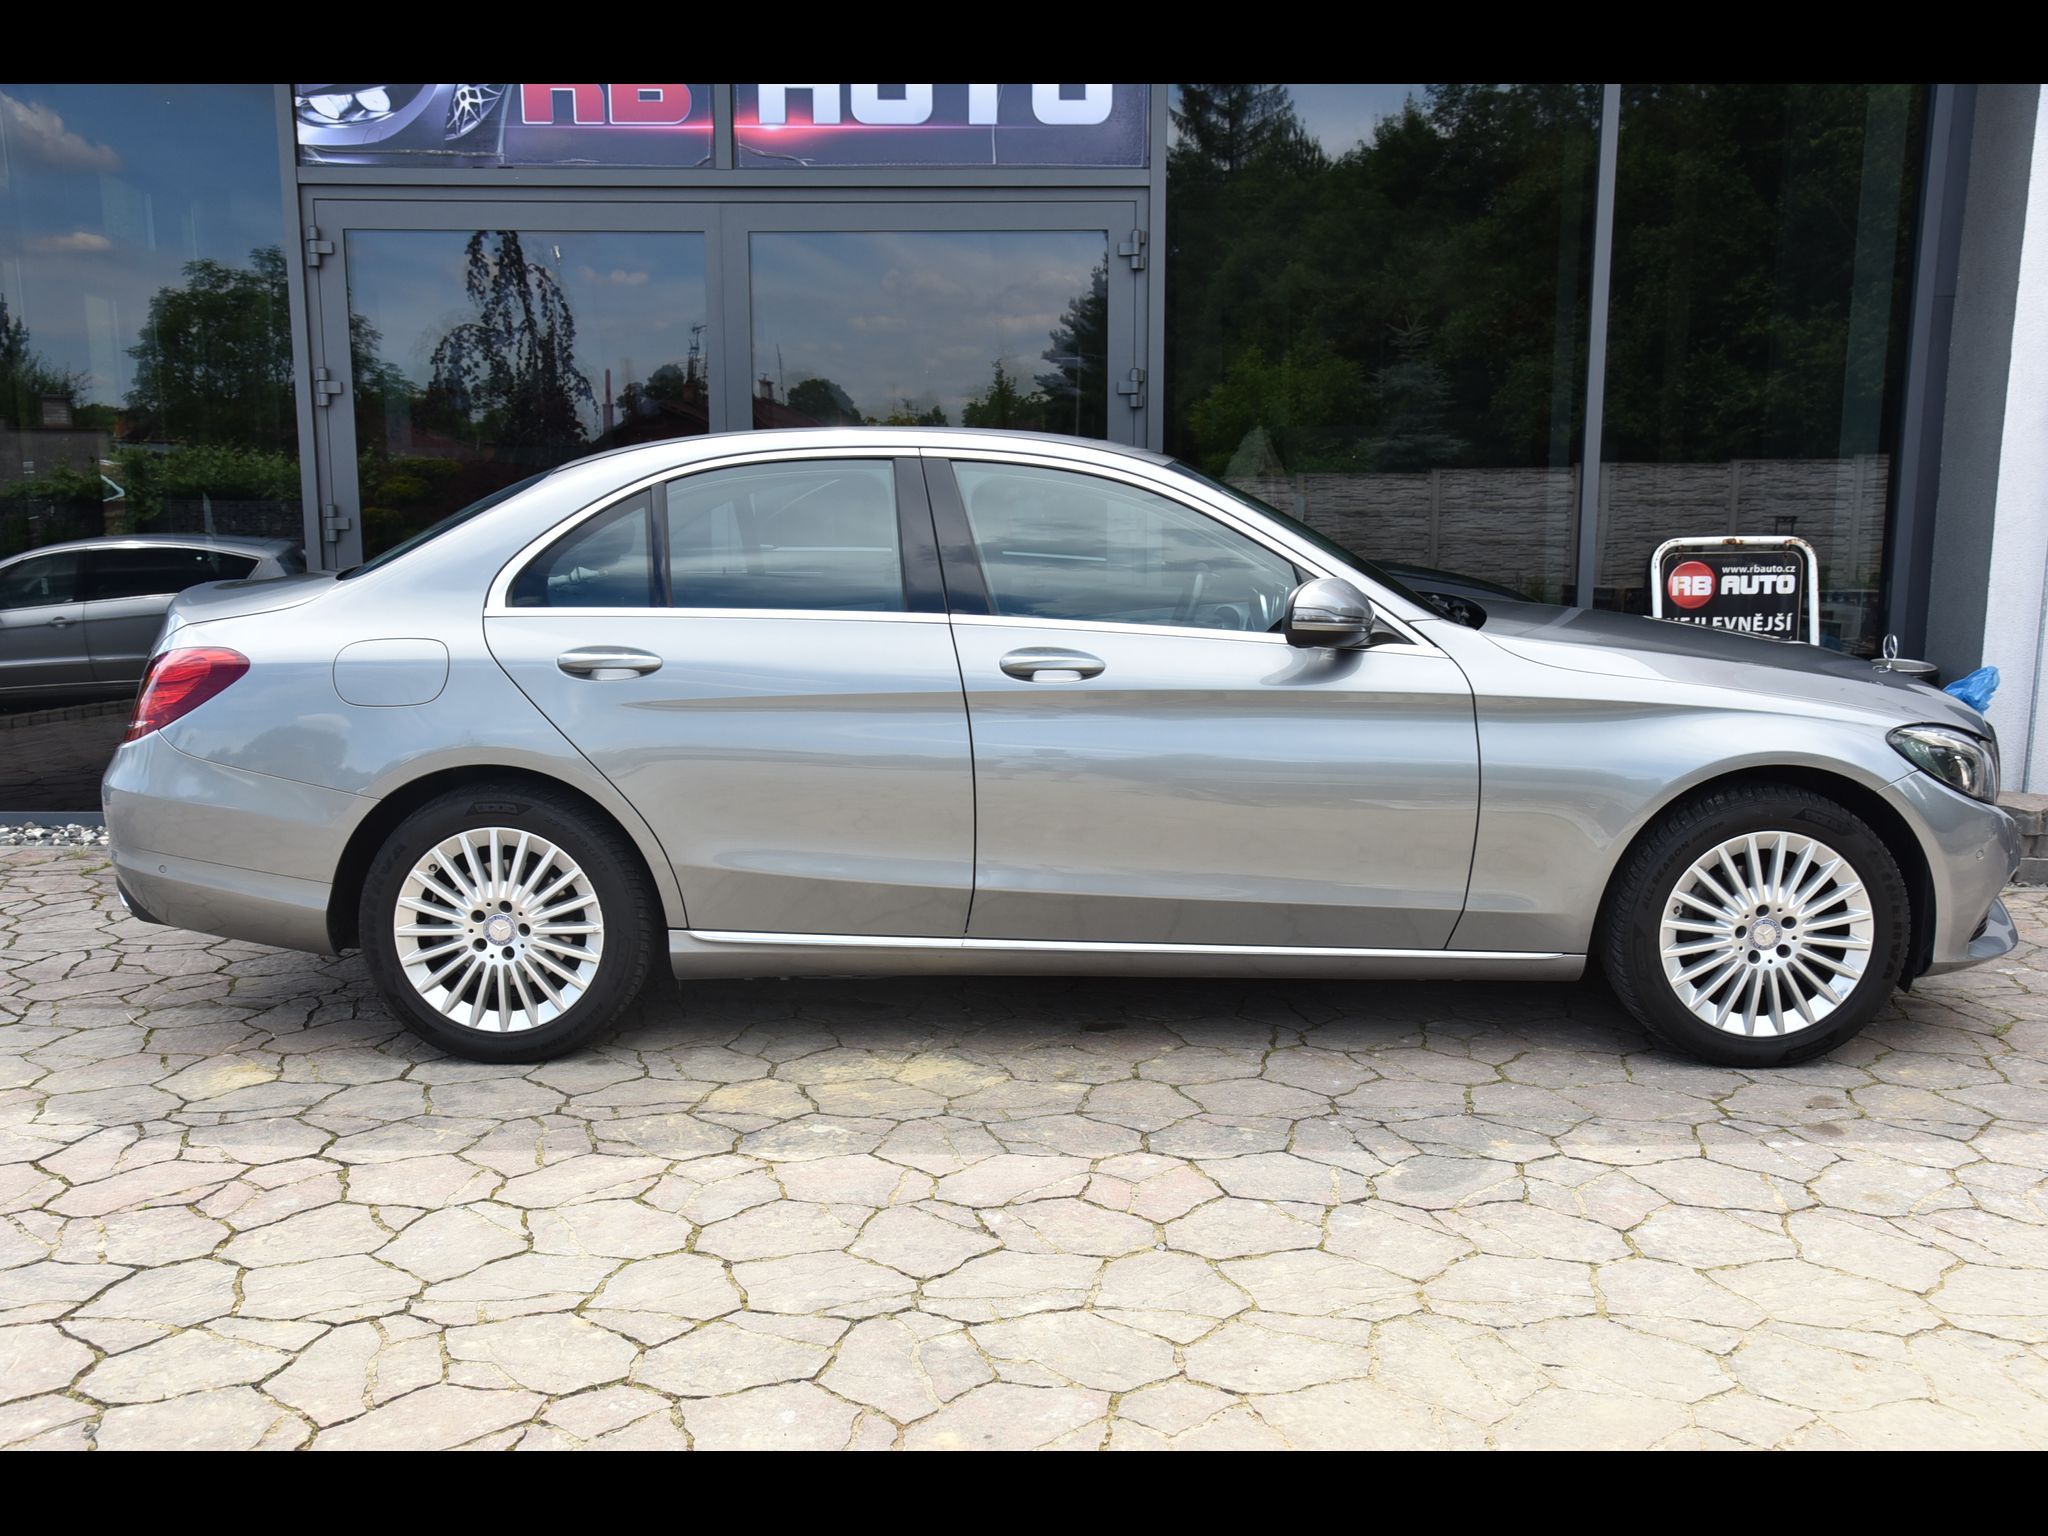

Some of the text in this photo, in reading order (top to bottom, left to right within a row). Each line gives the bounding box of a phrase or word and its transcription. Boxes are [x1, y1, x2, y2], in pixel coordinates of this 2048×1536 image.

[1722, 565, 1796, 573] www.rbauto.cz
[1672, 575, 1796, 596] RB AUTO
[1667, 613, 1793, 631] EVNĚJŠÍ
